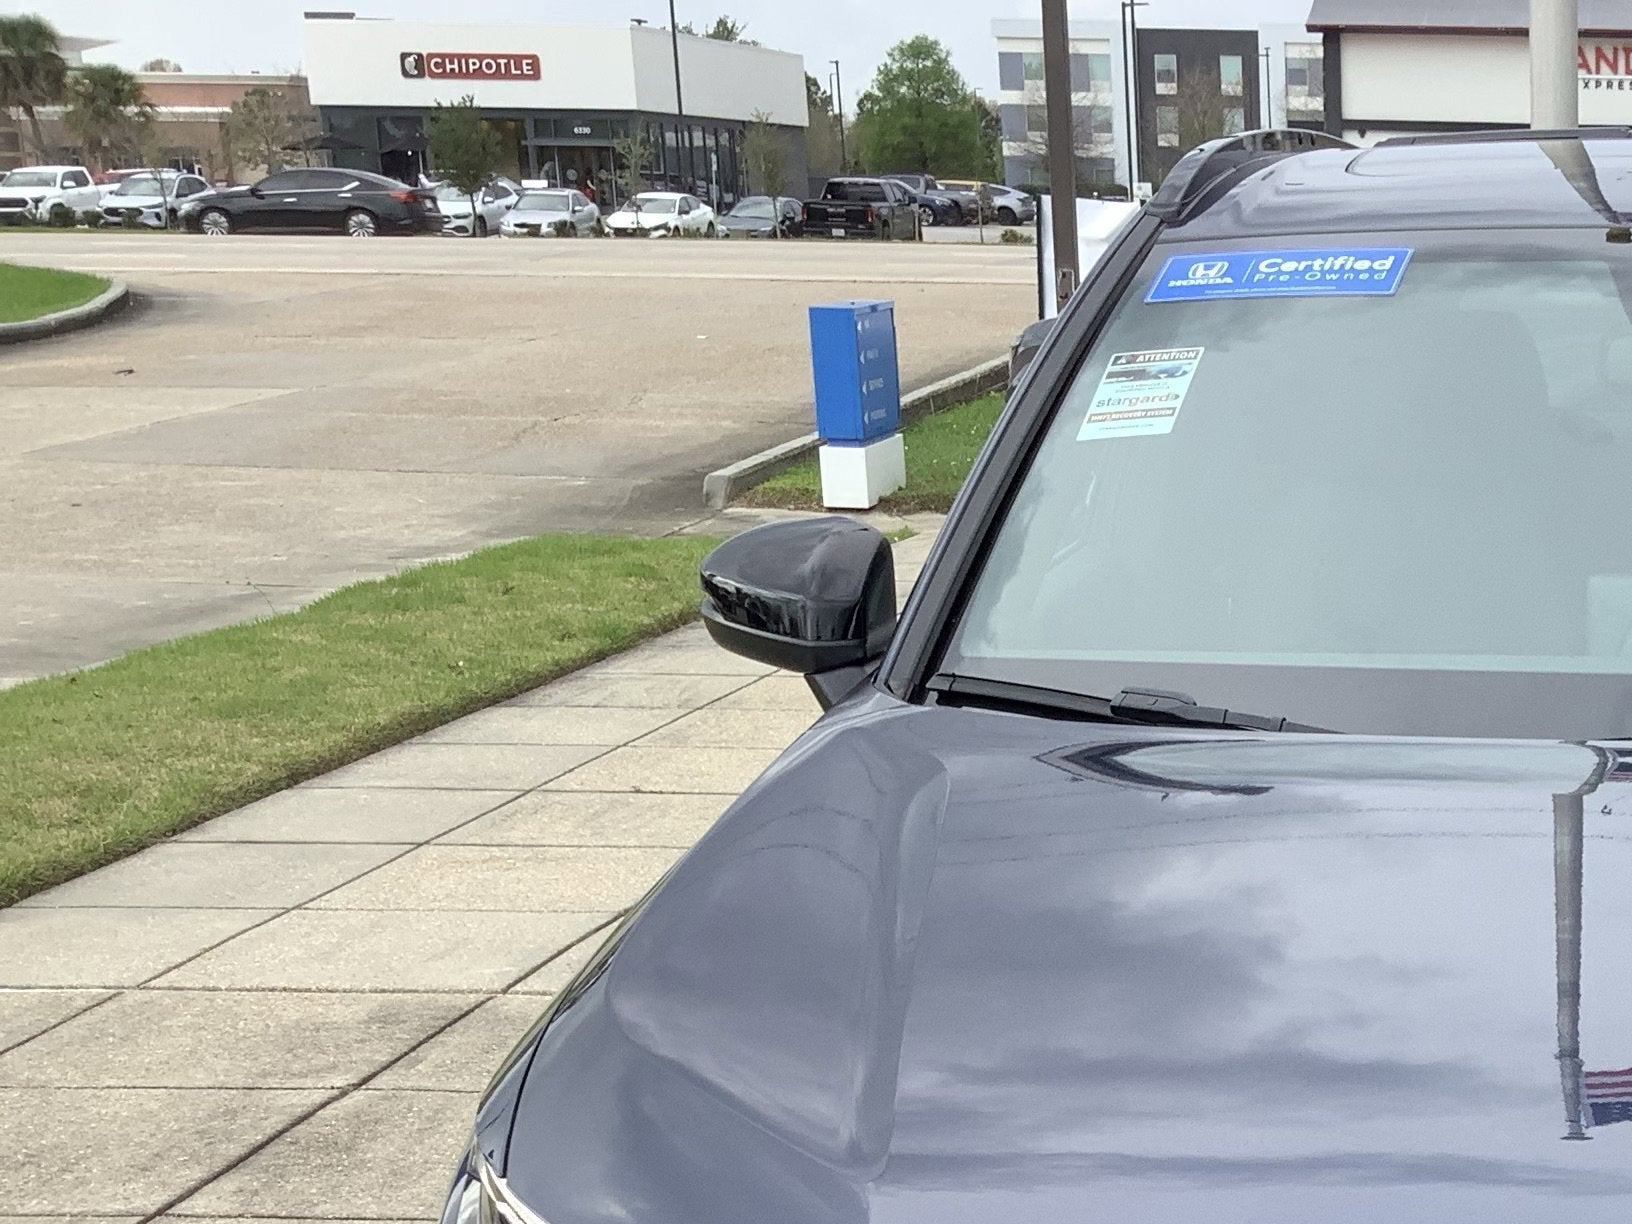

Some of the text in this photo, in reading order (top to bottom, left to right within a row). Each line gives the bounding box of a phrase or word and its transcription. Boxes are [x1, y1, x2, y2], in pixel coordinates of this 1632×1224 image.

[430, 58, 534, 74] CHIPOTLE
[1258, 255, 1396, 273] Certified
[1167, 276, 1235, 288] HONDA
[1253, 271, 1387, 283] Pre-Owned
[1135, 351, 1197, 363] ATTENTION
